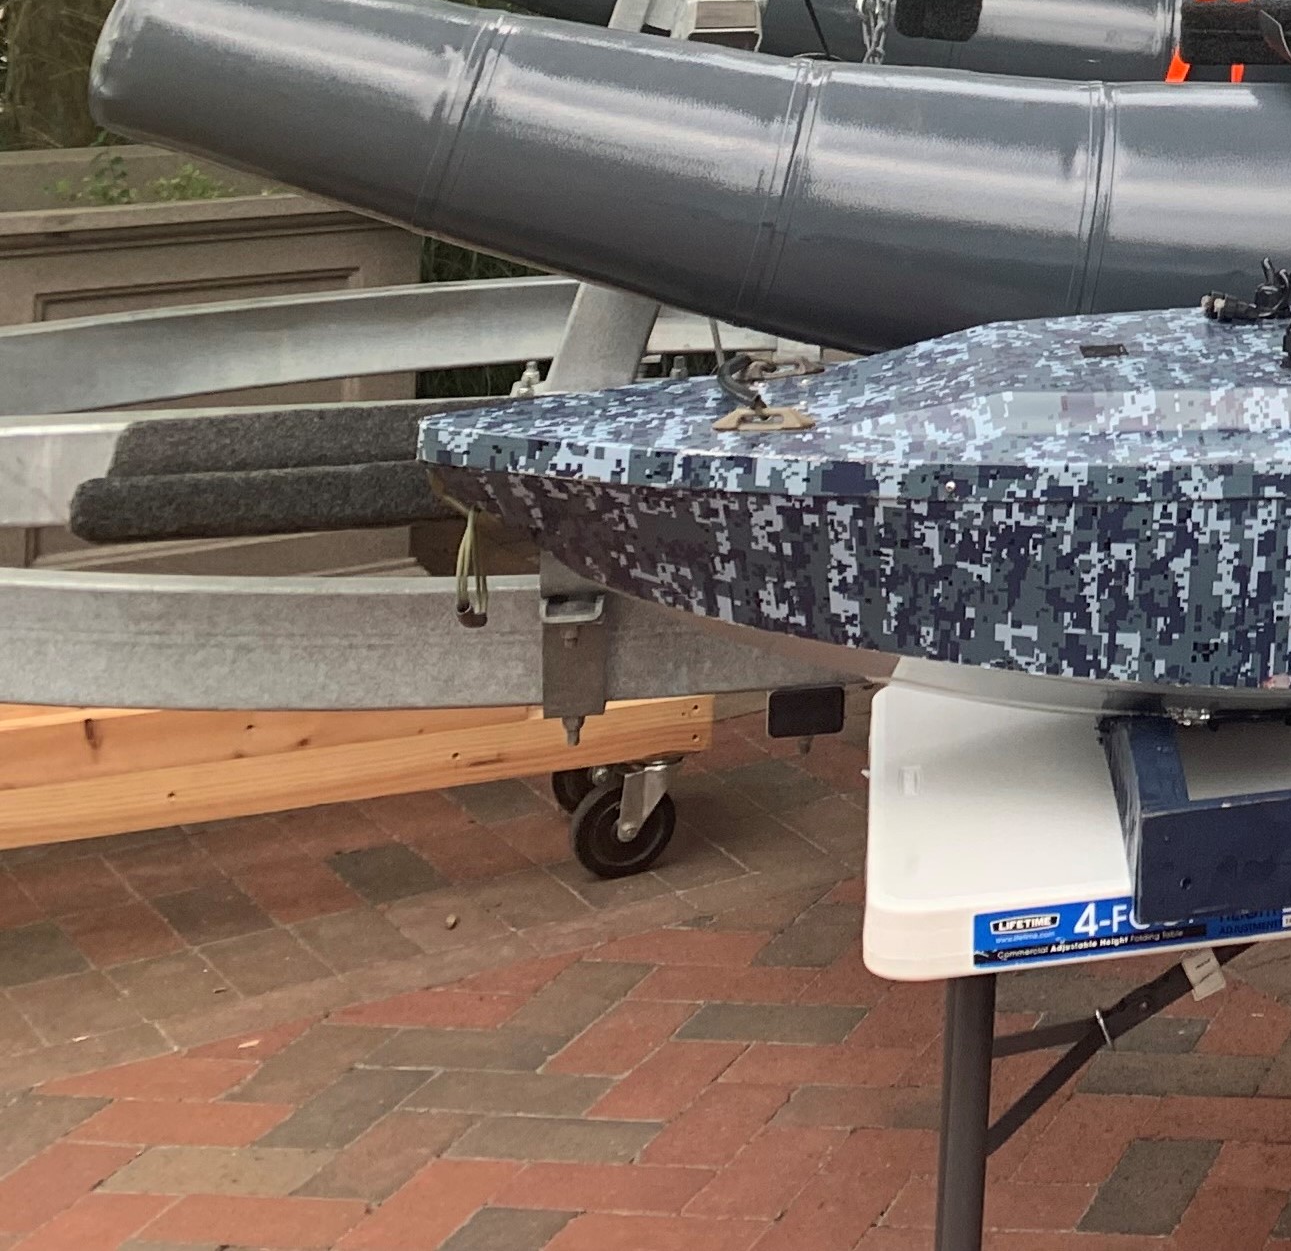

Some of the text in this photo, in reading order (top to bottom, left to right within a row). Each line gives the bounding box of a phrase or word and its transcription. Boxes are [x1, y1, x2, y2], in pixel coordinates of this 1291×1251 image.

[998, 915, 1052, 931] LIFETIME
[997, 945, 1049, 960] Commercial
[1050, 940, 1097, 954] Adjustable
[1099, 936, 1129, 950] Height
